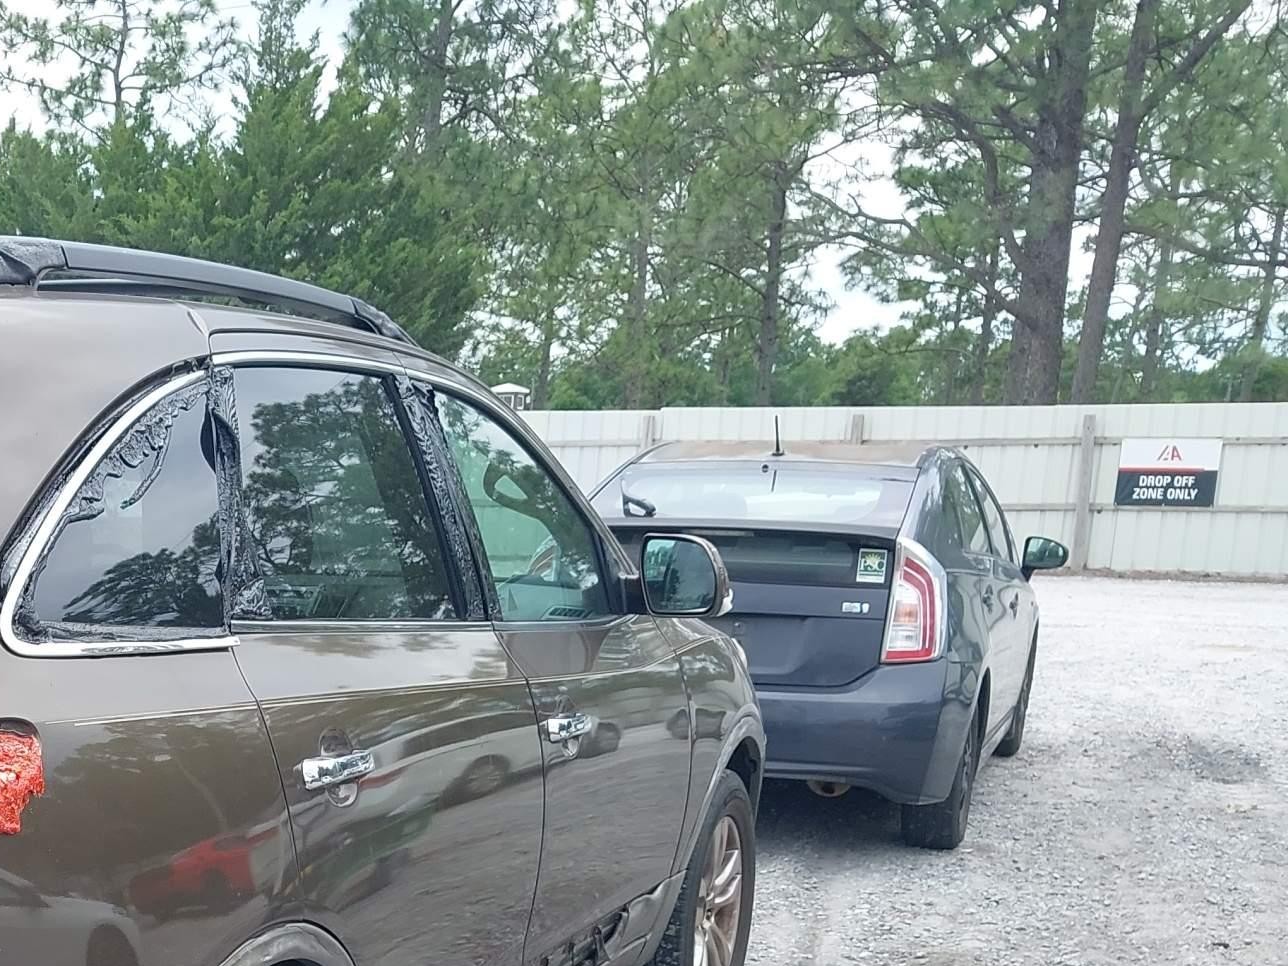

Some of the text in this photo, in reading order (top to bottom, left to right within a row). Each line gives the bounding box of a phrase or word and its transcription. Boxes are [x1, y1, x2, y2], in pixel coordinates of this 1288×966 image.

[1139, 475, 1196, 488] DROP OFF
[1132, 488, 1198, 500] ZONE ONLY
